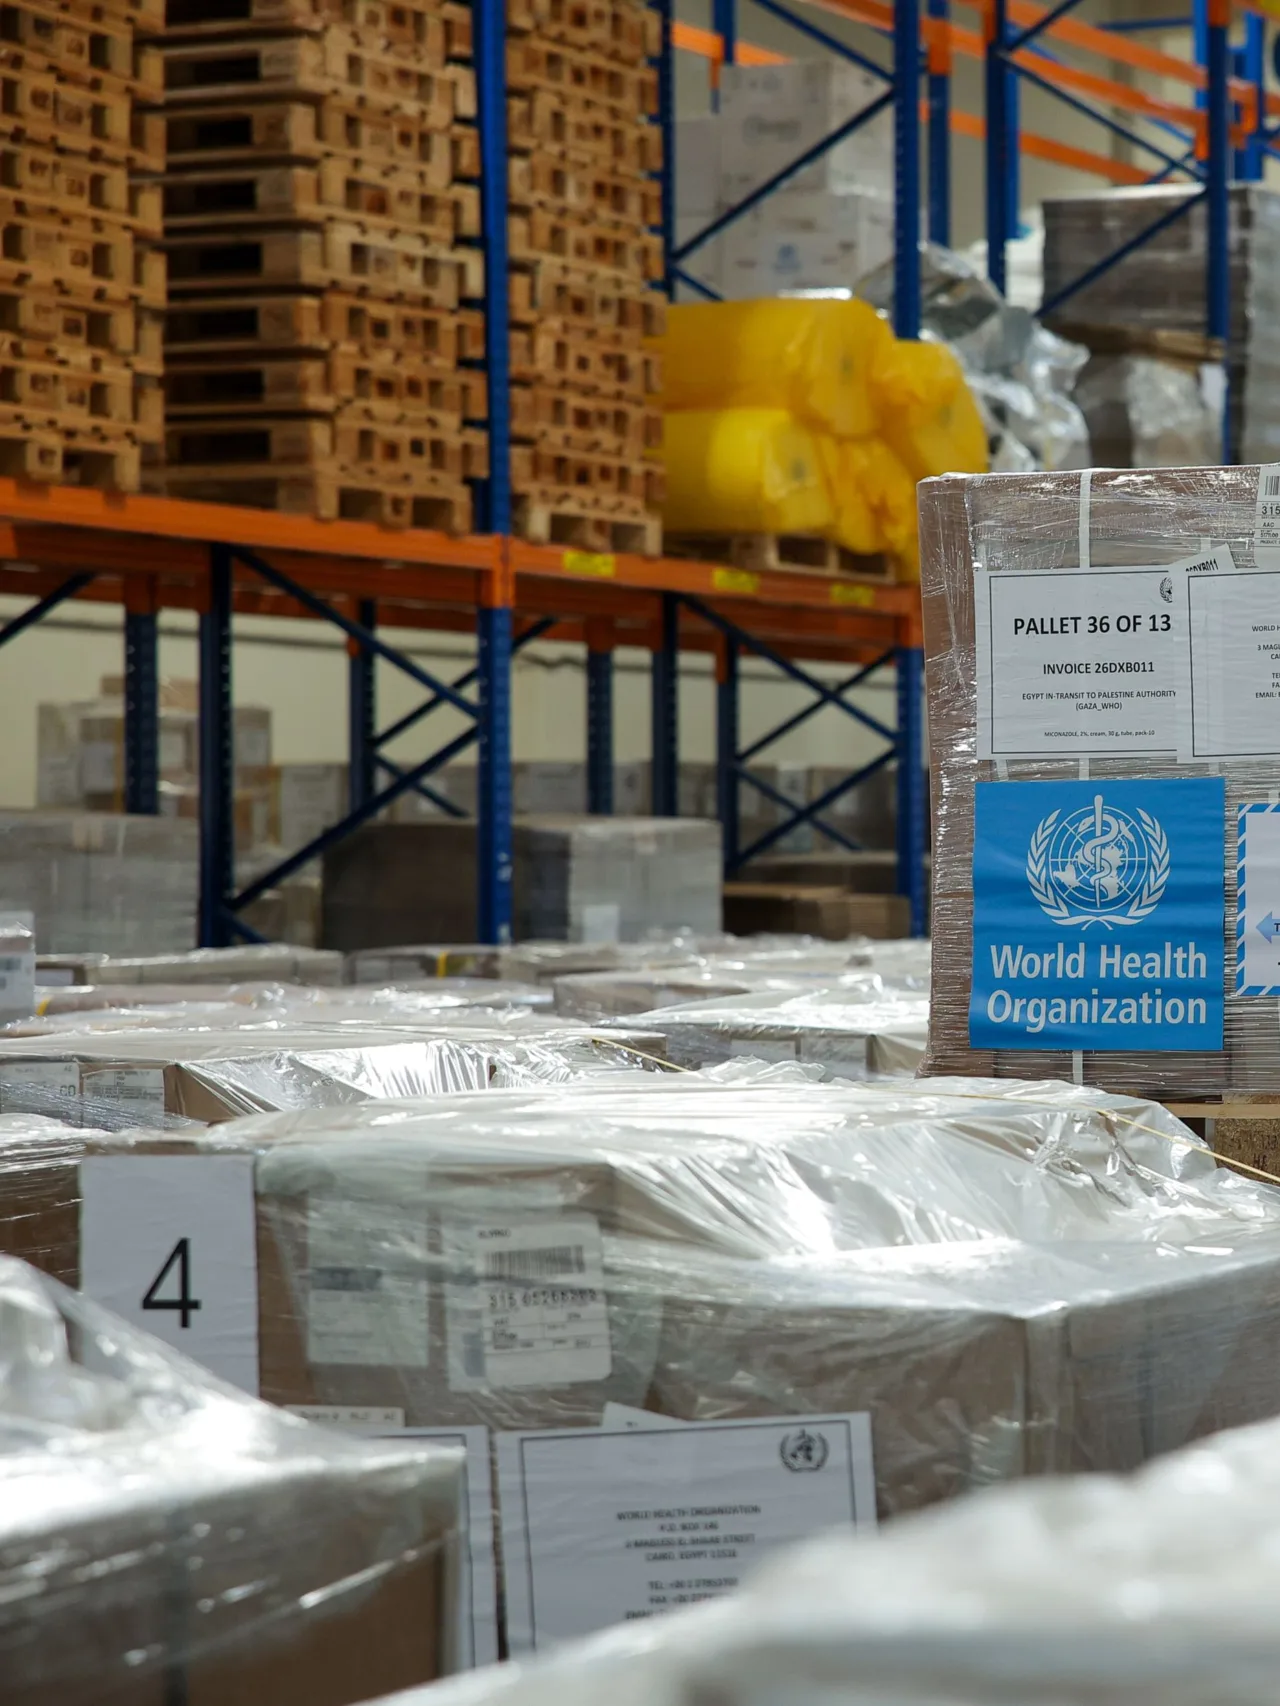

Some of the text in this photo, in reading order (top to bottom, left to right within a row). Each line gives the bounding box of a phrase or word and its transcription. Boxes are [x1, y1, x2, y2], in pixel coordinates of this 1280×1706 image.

[1262, 506, 1280, 515] 315
[1014, 614, 1171, 635] PALLET 36 OF 13
[1043, 662, 1155, 674] INVOICE 26DXB011
[1022, 692, 1044, 700] EGYPT
[1046, 692, 1084, 700] IN-TRANSIT
[1098, 691, 1134, 699] PALESTINE
[1136, 690, 1176, 698] AUTHORITY
[1076, 702, 1122, 711] (GAZA_WHO)
[990, 942, 1207, 979] World Health
[986, 988, 1206, 1033] Organization
[142, 1237, 202, 1329] 4
